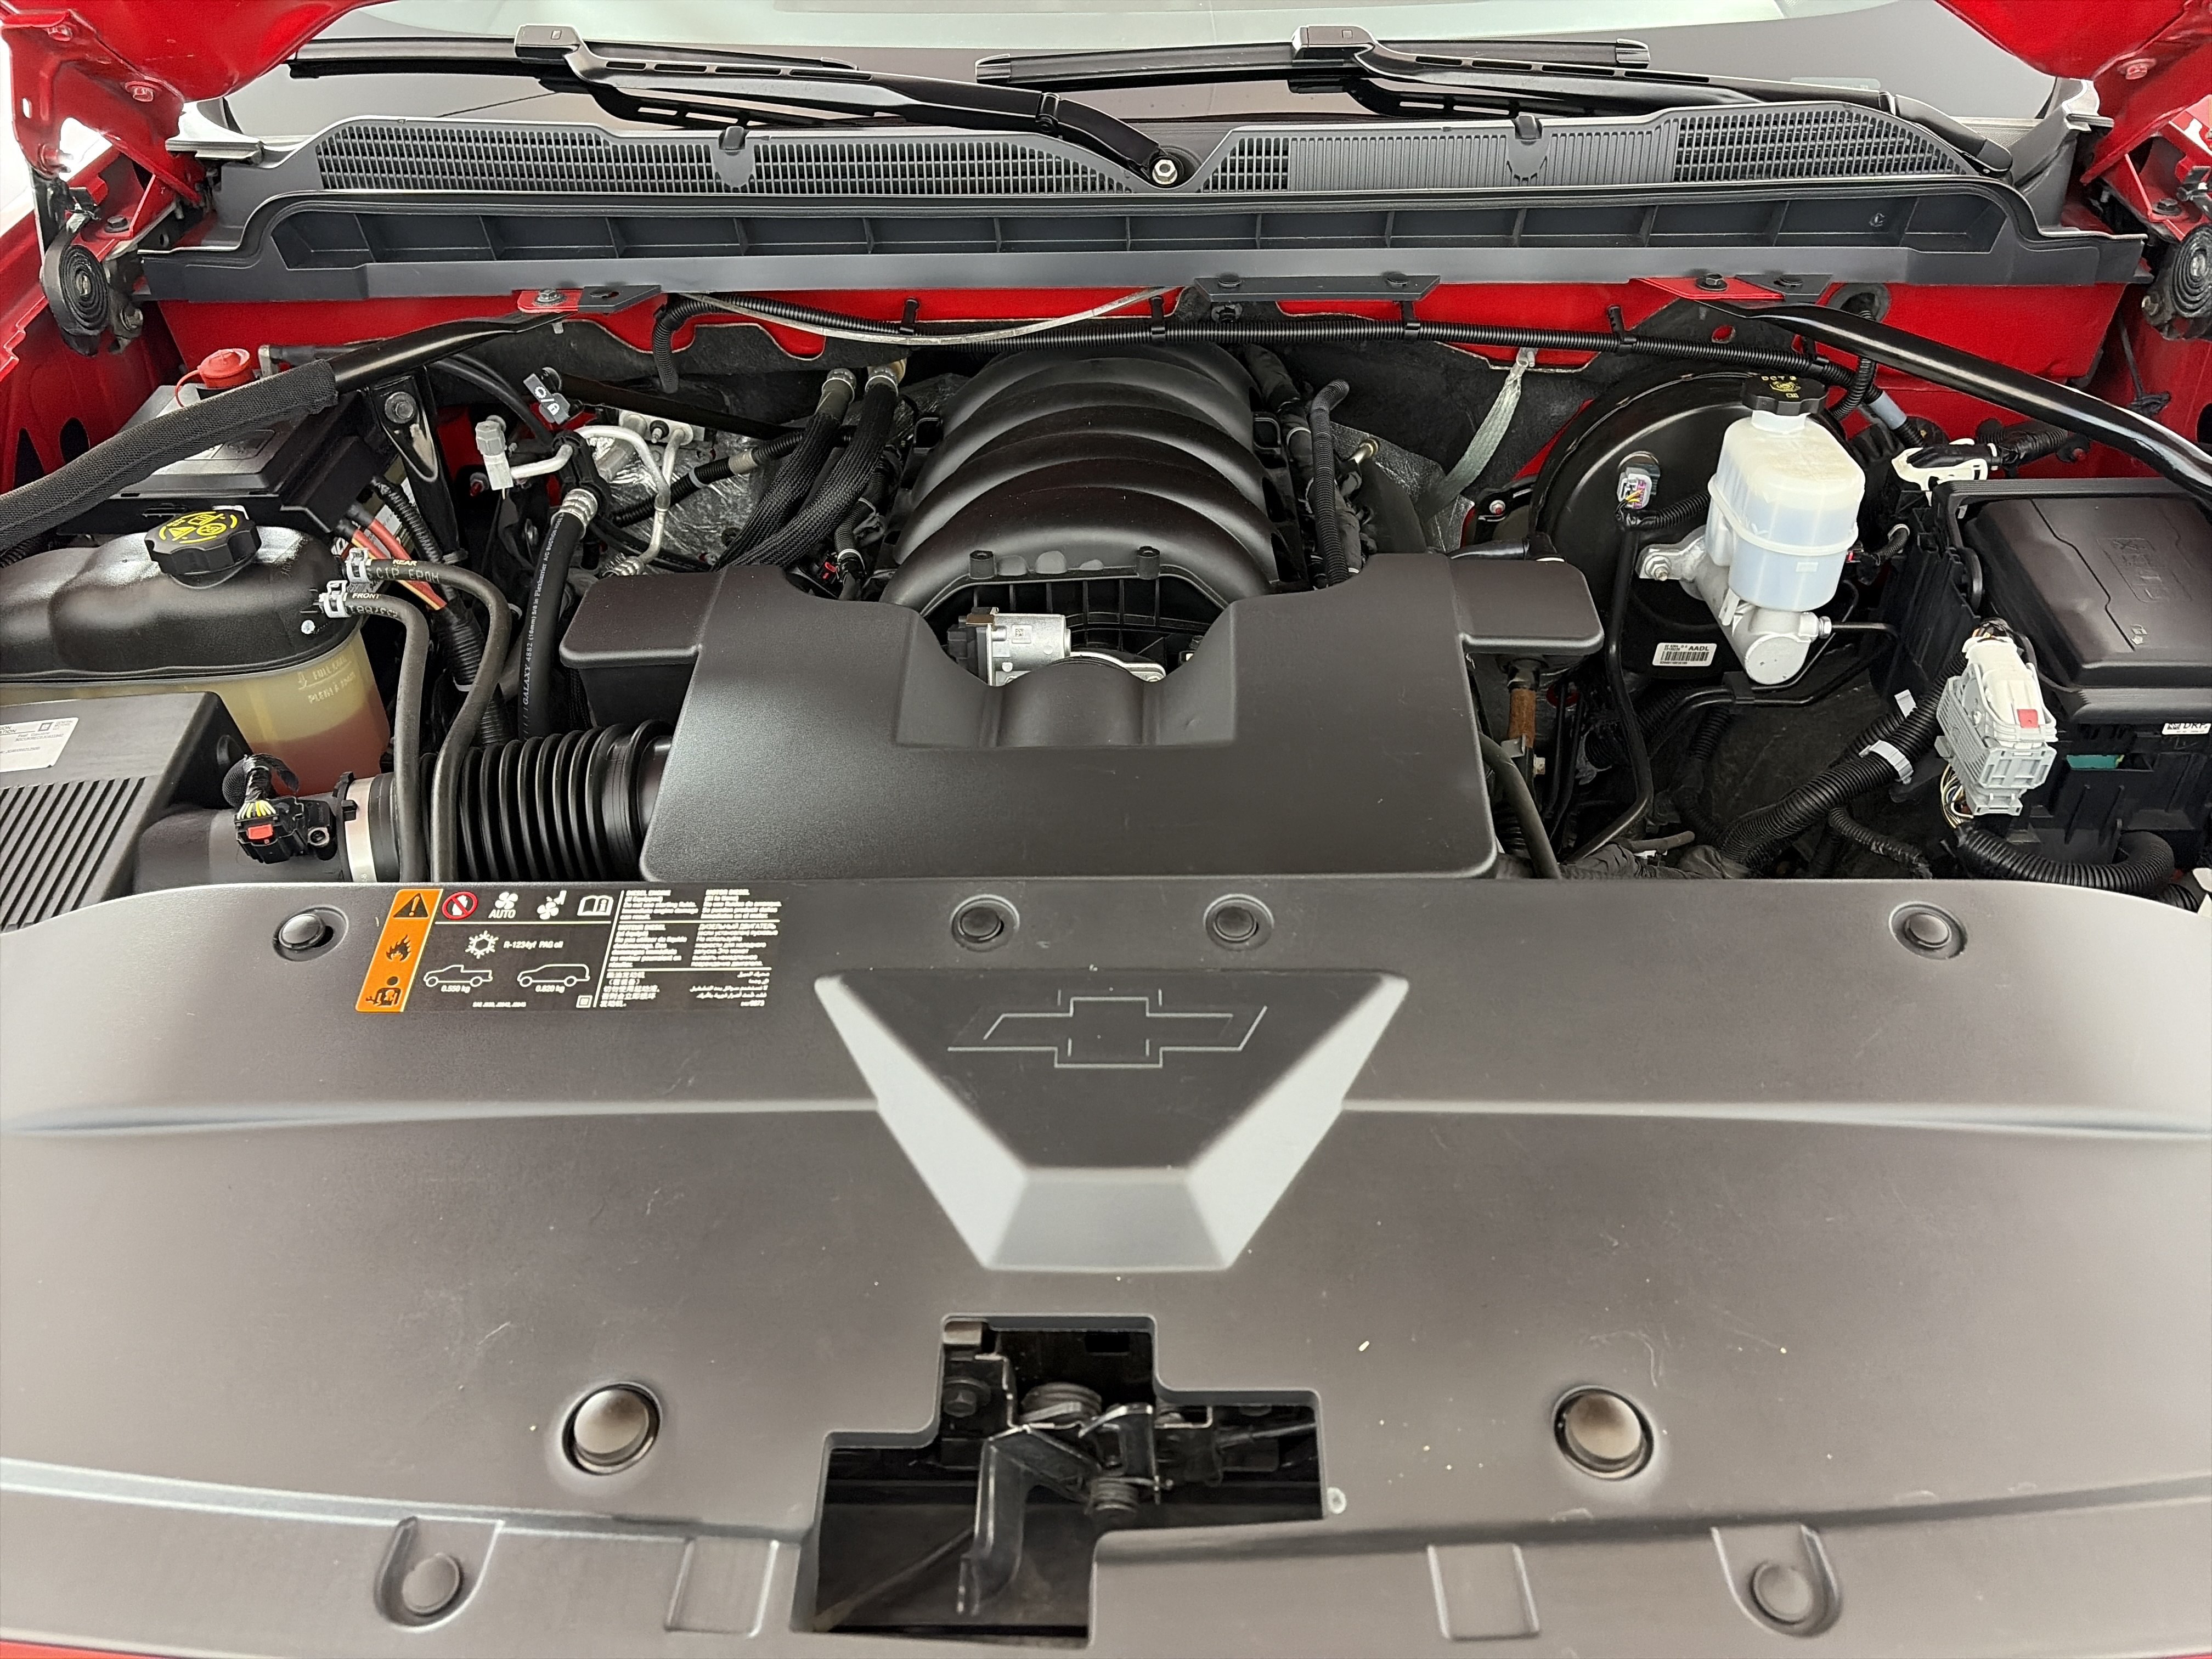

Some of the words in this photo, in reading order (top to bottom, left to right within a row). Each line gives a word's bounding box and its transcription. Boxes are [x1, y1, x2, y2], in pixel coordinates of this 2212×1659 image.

[534, 563, 547, 597] Flexbarrier
[546, 529, 557, 551] SUCTION
[488, 909, 516, 918] AUTO
[503, 941, 537, 950] R-1234yf
